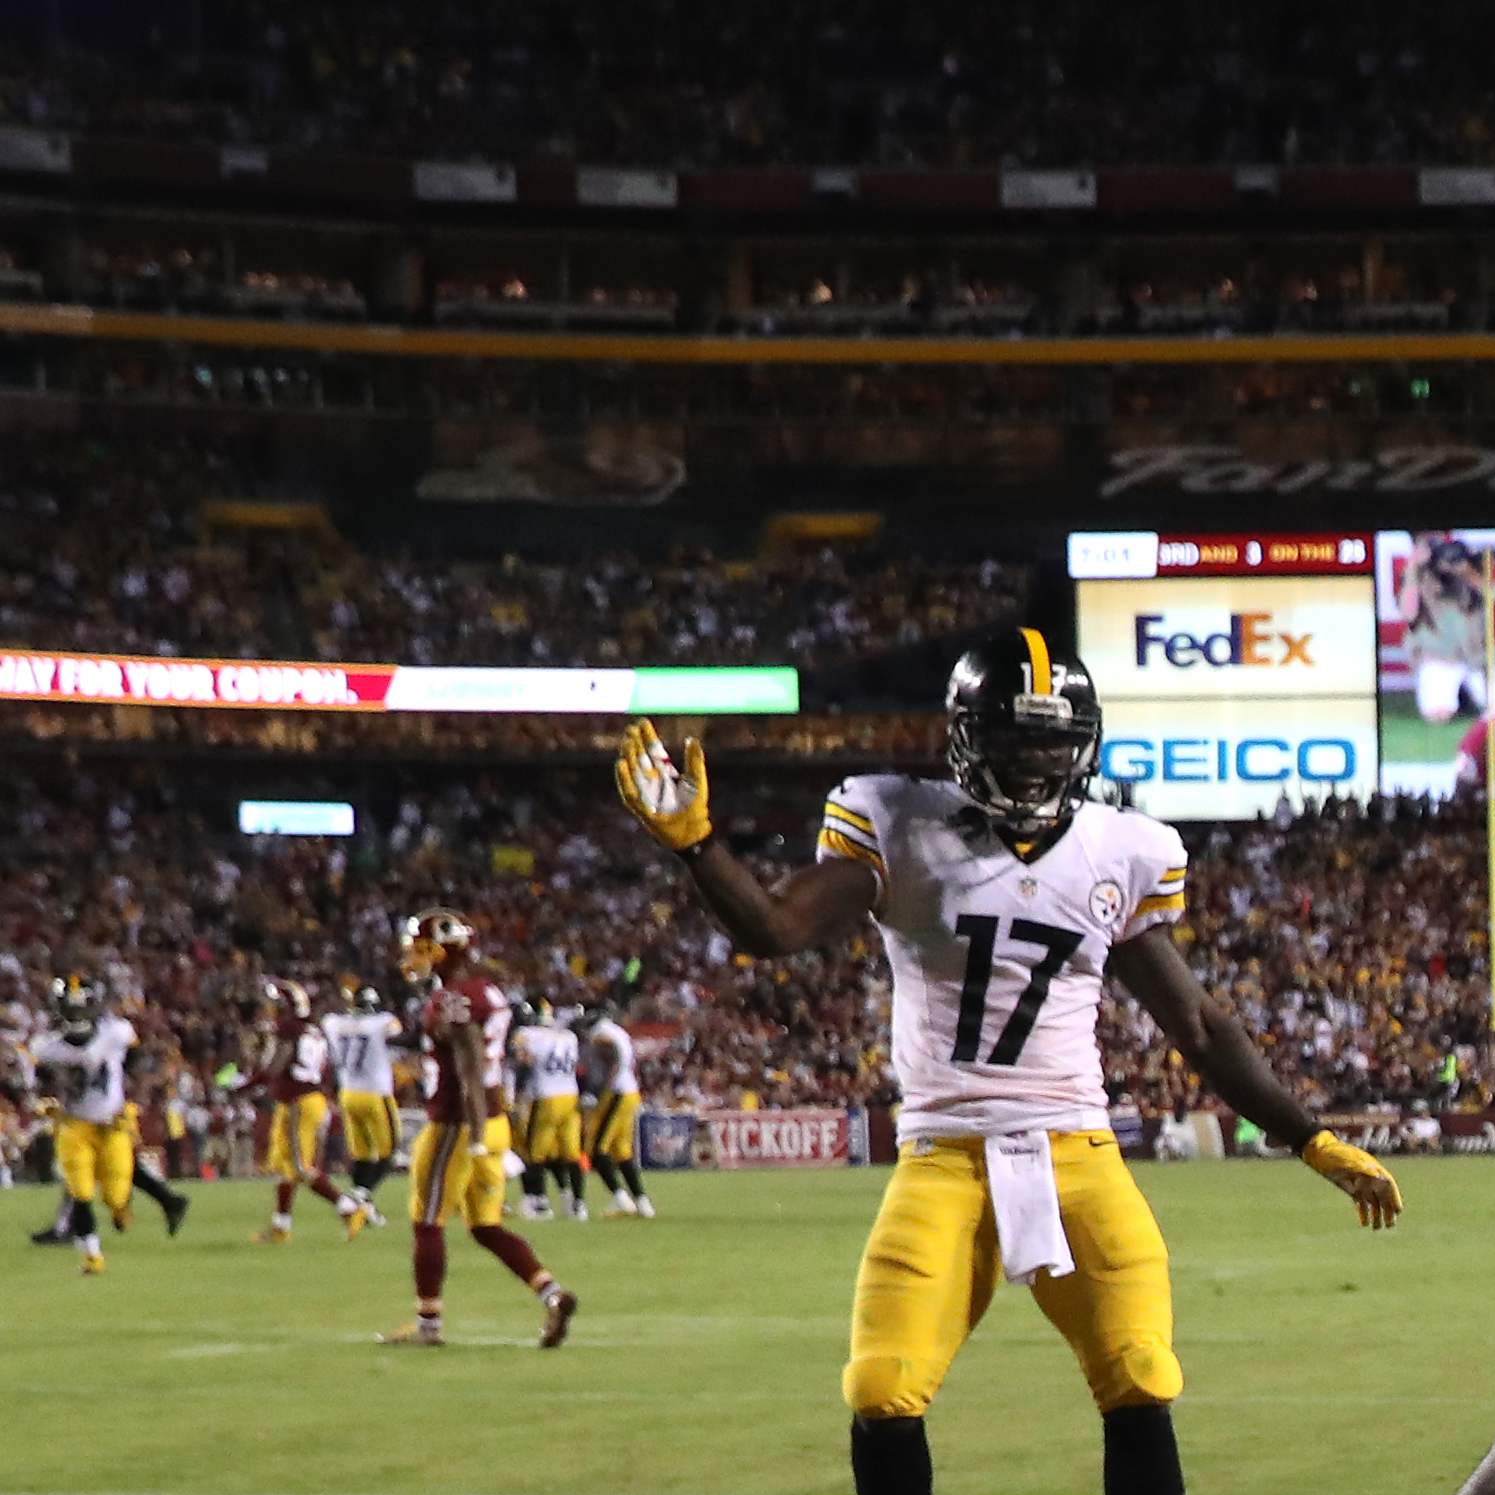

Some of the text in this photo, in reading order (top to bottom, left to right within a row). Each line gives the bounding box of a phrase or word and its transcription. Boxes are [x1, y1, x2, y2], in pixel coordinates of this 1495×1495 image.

[1135, 612, 1313, 667] FedEx
[58, 658, 123, 698] FOR
[124, 661, 217, 700] YOUR
[217, 665, 358, 705] COUPON.
[1100, 738, 1357, 783] GEICO
[951, 914, 1085, 1066] 17
[709, 1117, 839, 1158] KICKOFF
